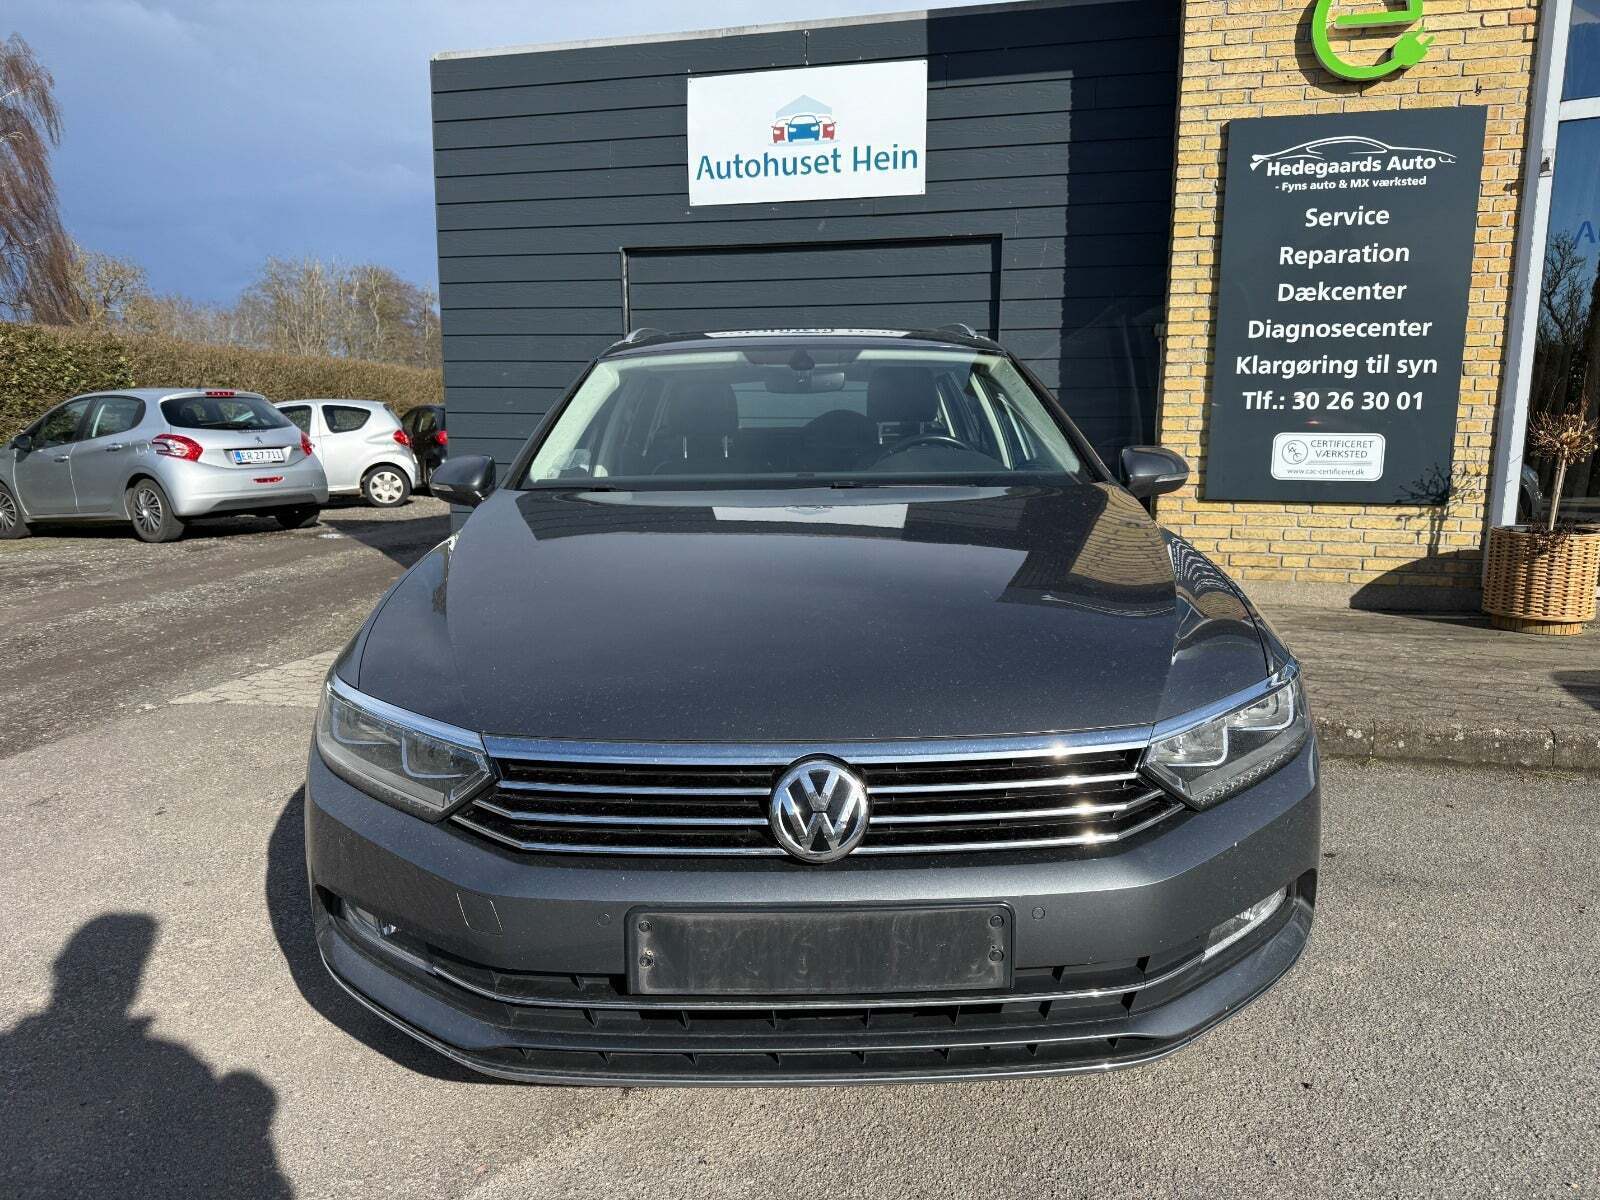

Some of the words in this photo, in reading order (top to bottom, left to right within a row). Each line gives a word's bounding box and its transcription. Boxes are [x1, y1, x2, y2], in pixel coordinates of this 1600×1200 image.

[696, 148, 842, 181] Autohuset
[853, 144, 918, 172] Hein
[1266, 158, 1382, 178] Hedegaards
[1387, 155, 1437, 171] Auto
[1281, 181, 1308, 194] Fyns
[1309, 180, 1337, 191] auto
[1338, 178, 1348, 189] &
[1349, 178, 1370, 189] MX
[1372, 175, 1428, 188] værksted
[1304, 205, 1390, 228] Service
[1279, 243, 1410, 270] Reparation
[1277, 281, 1408, 302] Dækcenter
[1247, 319, 1433, 343] Diagnosecenter
[1235, 355, 1359, 379] Klargøring
[1366, 354, 1390, 374] til
[1396, 358, 1438, 379] syn
[1242, 390, 1285, 410] Tlf.:
[1292, 391, 1320, 411] 30
[1326, 391, 1354, 411] 26
[1361, 391, 1390, 411] 30
[1396, 391, 1424, 411] 01
[1310, 439, 1376, 449] CERTIFICERET
[1315, 449, 1369, 459] VÆRKSTED
